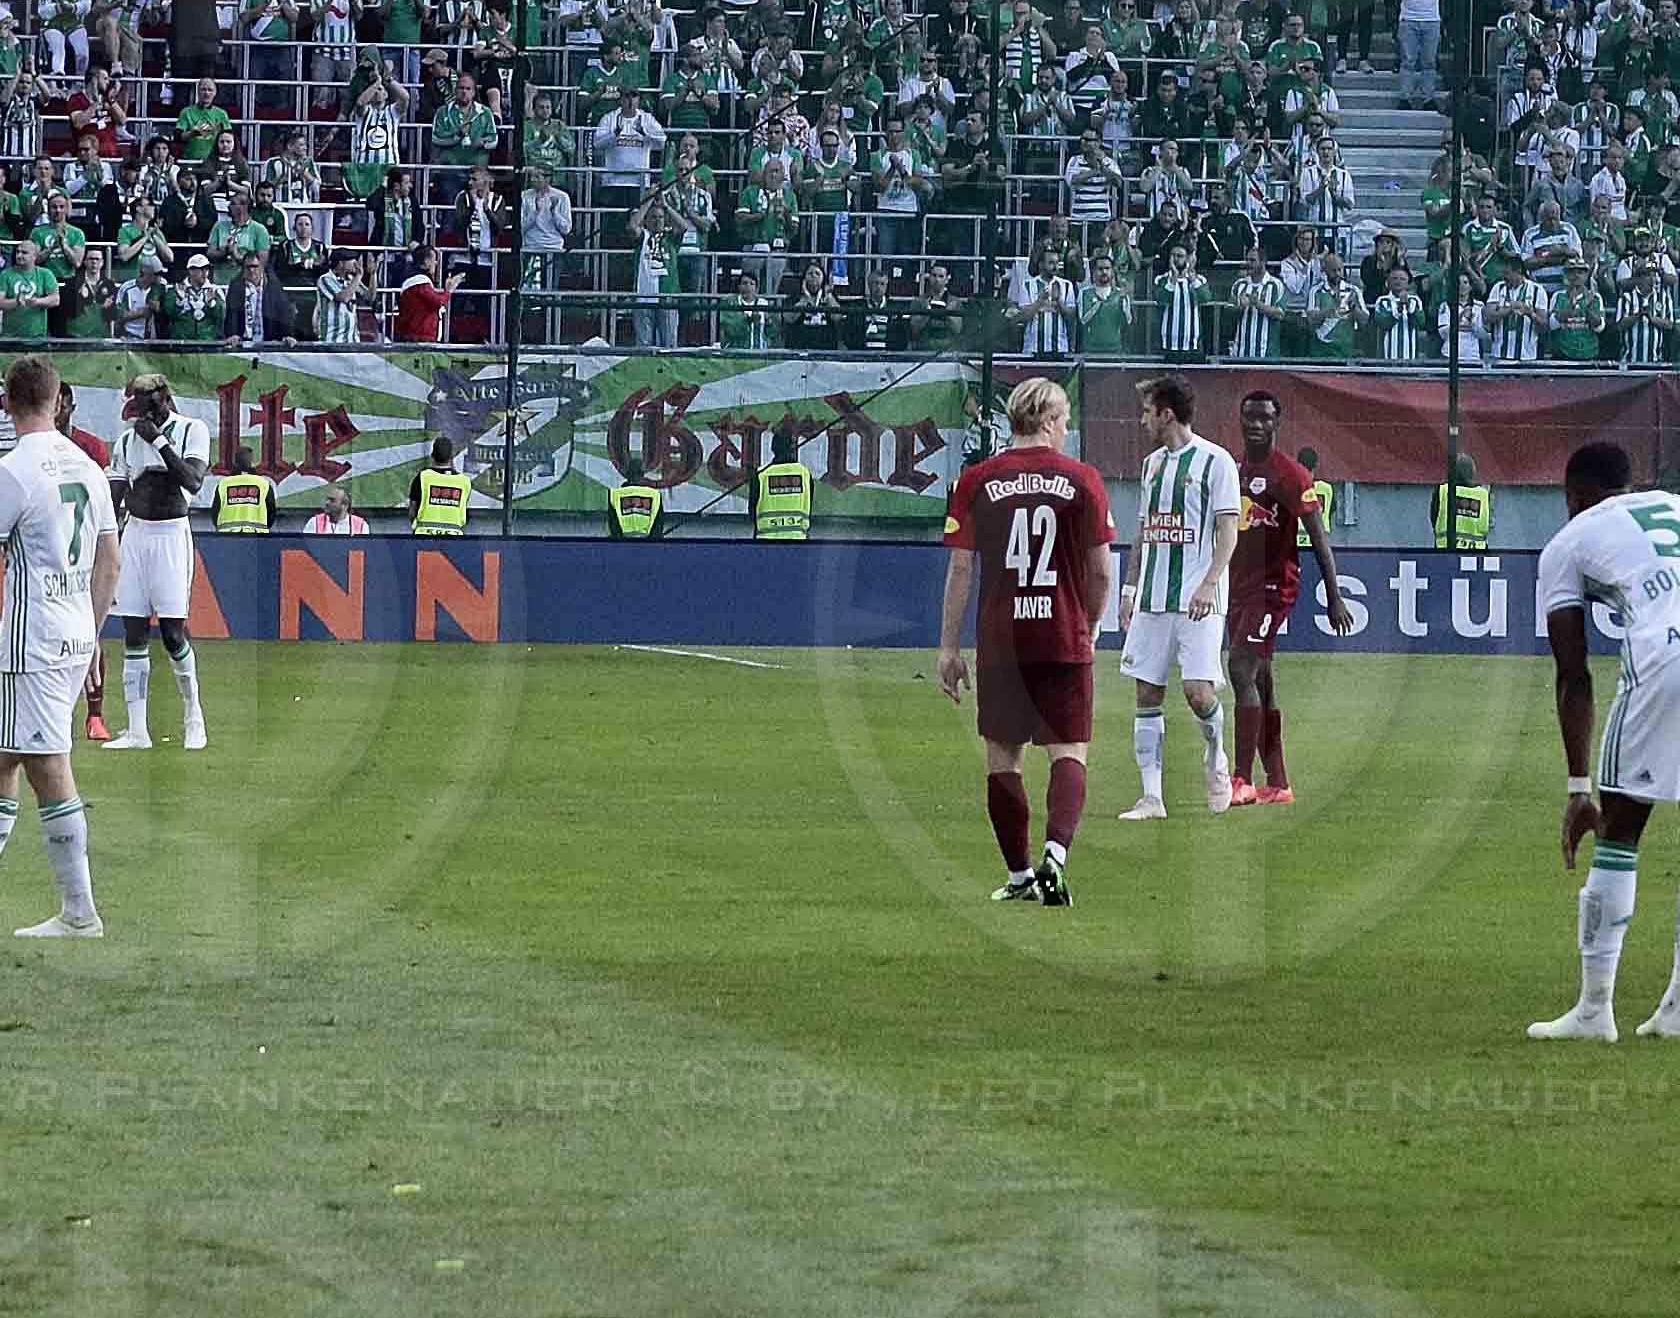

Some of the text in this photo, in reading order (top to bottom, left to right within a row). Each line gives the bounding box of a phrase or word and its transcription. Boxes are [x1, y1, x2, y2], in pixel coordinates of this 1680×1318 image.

[59, 482, 90, 565] 7
[1152, 514, 1182, 526] WIEN
[1005, 505, 1058, 587] 42
[1013, 595, 1052, 619] XAVER
[1259, 613, 1272, 637] 8
